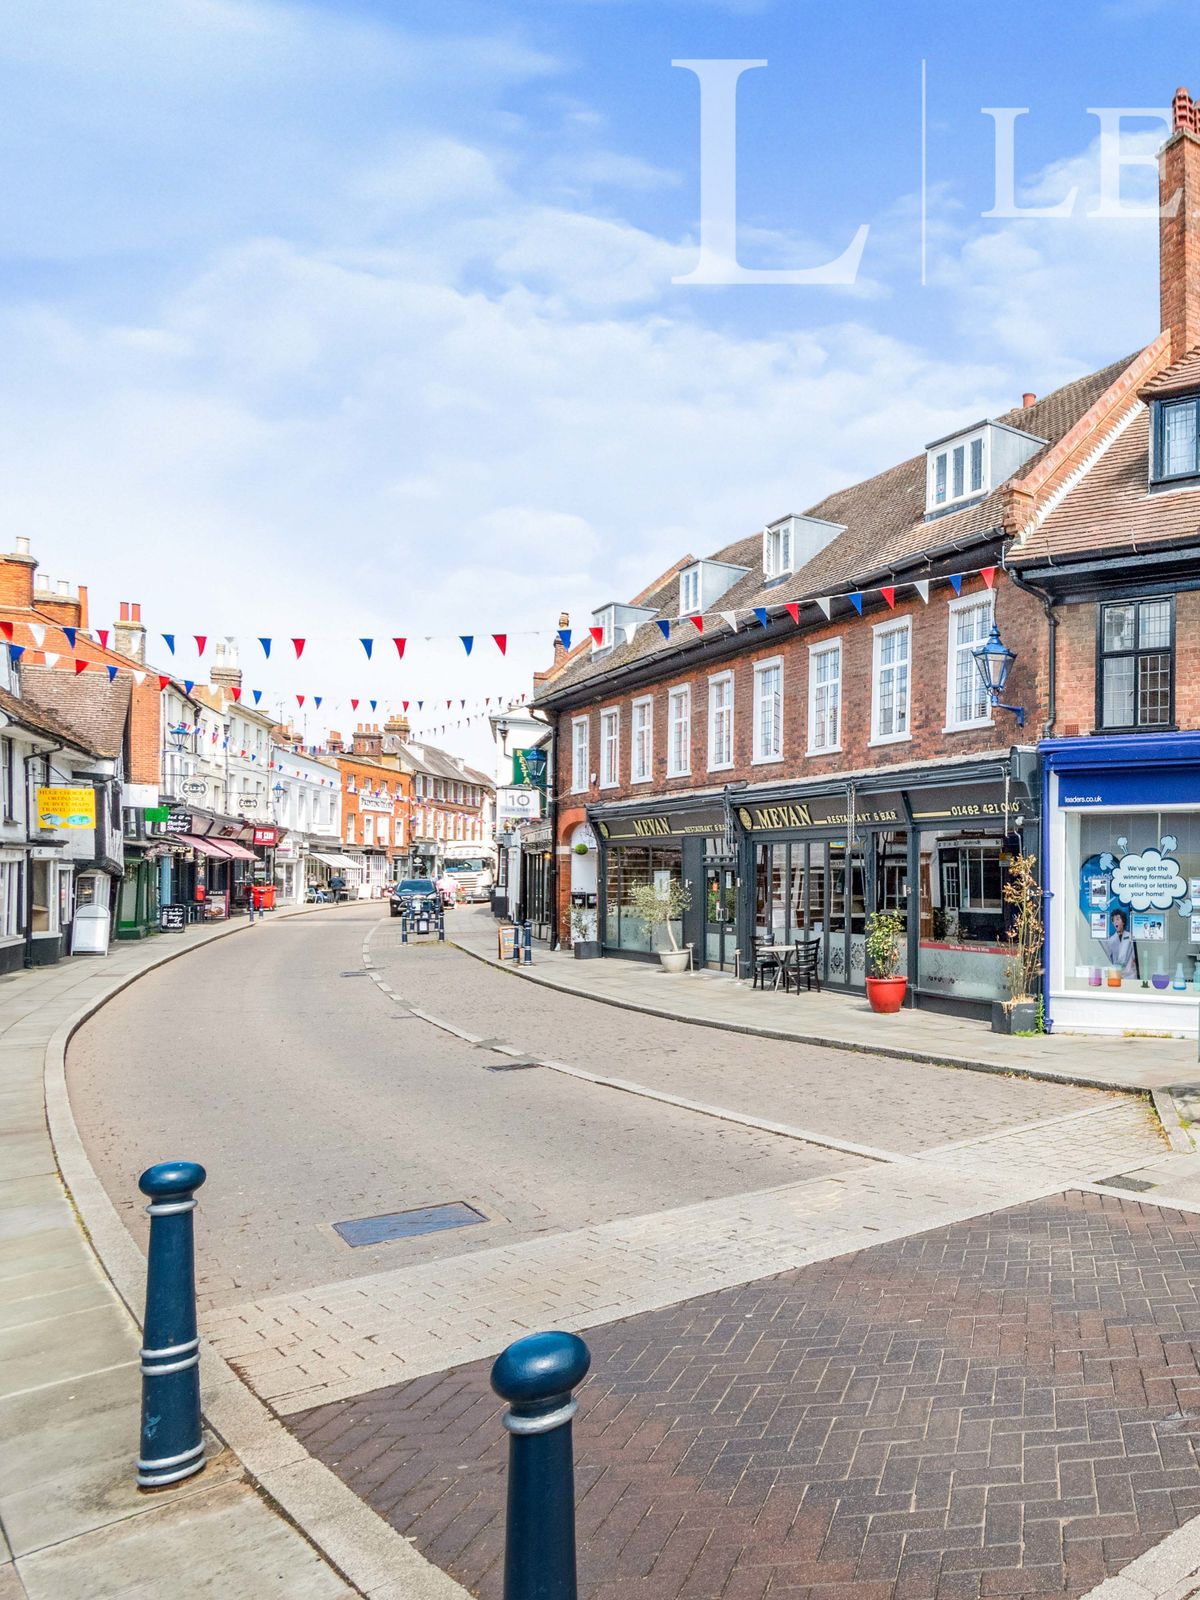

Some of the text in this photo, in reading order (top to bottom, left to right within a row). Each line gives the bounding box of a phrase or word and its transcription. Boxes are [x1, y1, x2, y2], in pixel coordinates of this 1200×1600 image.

[508, 795, 530, 806] 10
[1064, 795, 1102, 803] leaders.co.uk
[951, 805, 980, 816] 01462
[982, 803, 999, 813] 421
[756, 804, 815, 830] MEVAN
[880, 811, 897, 821] BAR
[633, 817, 671, 836] MEVAN
